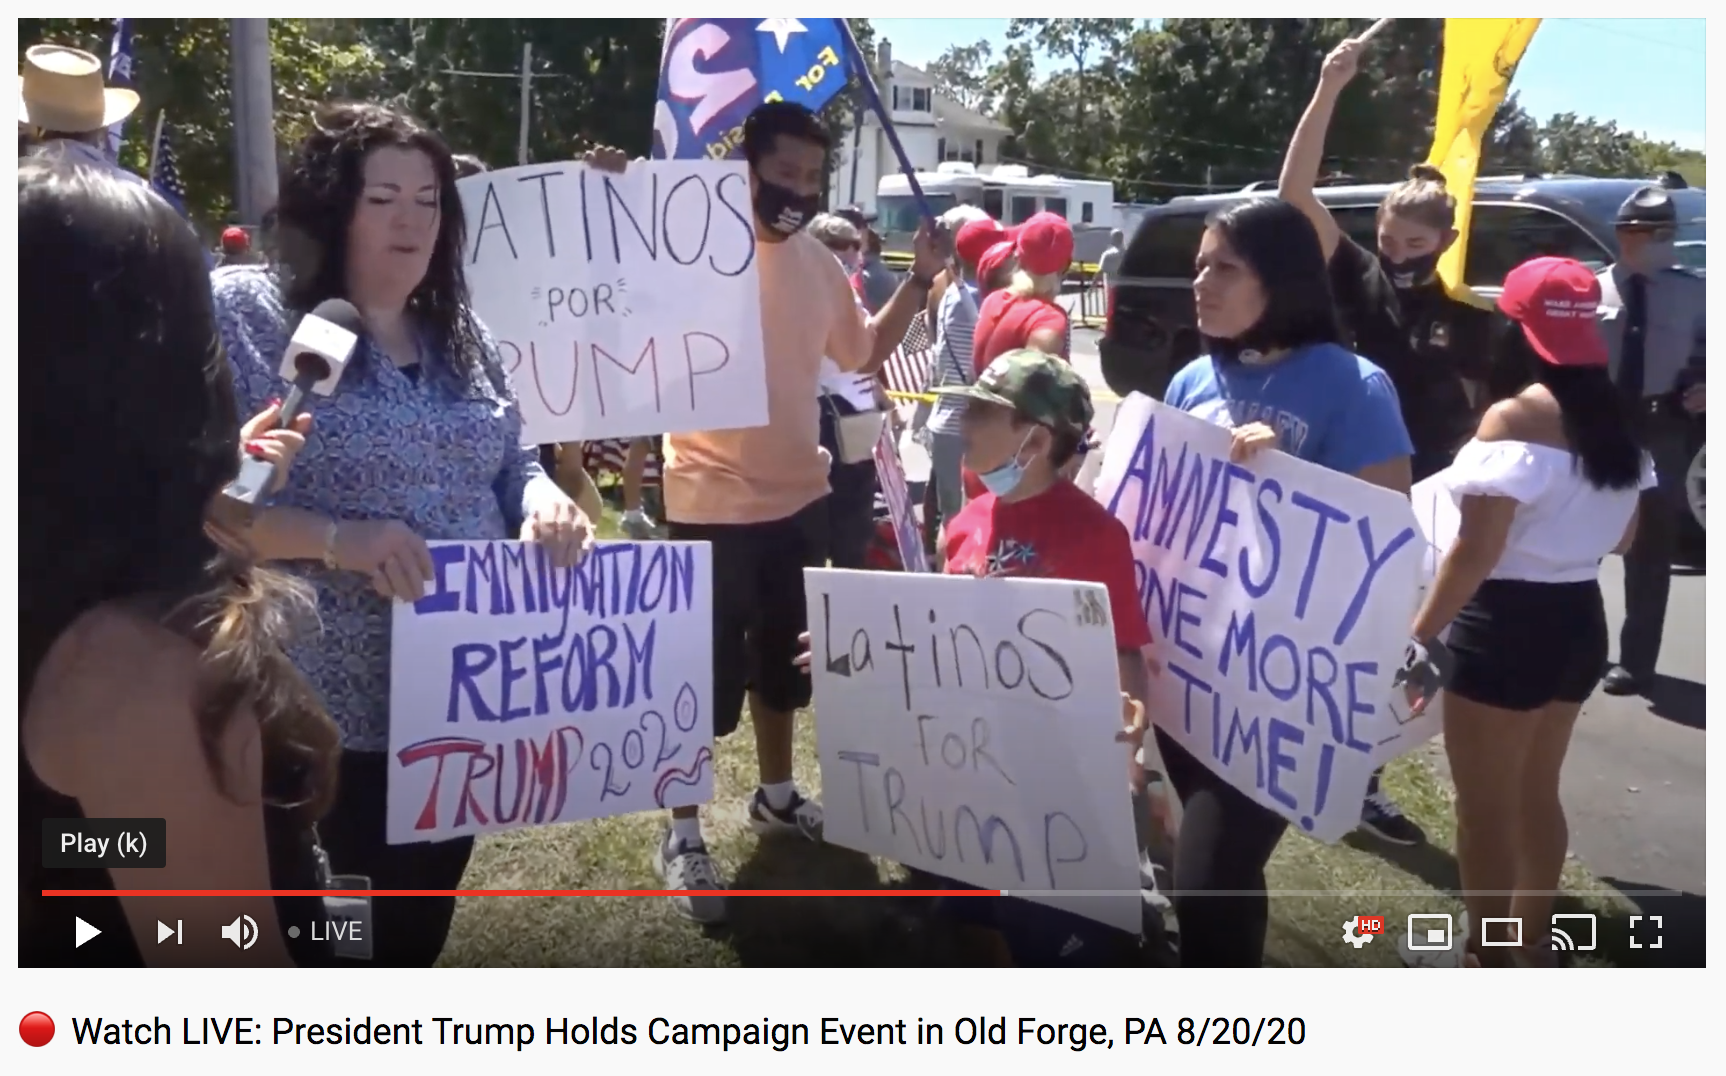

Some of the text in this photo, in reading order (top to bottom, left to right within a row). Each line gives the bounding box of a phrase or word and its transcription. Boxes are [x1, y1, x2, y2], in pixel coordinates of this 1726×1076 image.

[472, 169, 756, 277] ATINOS
[547, 282, 616, 323] POR
[1107, 413, 1415, 646] AMNESTY
[446, 619, 656, 723] REFORM
[1218, 609, 1378, 753] MORE
[397, 681, 698, 831] TRUMP 2020
[916, 714, 1017, 786] FOR
[1167, 661, 1335, 832] TIME!
